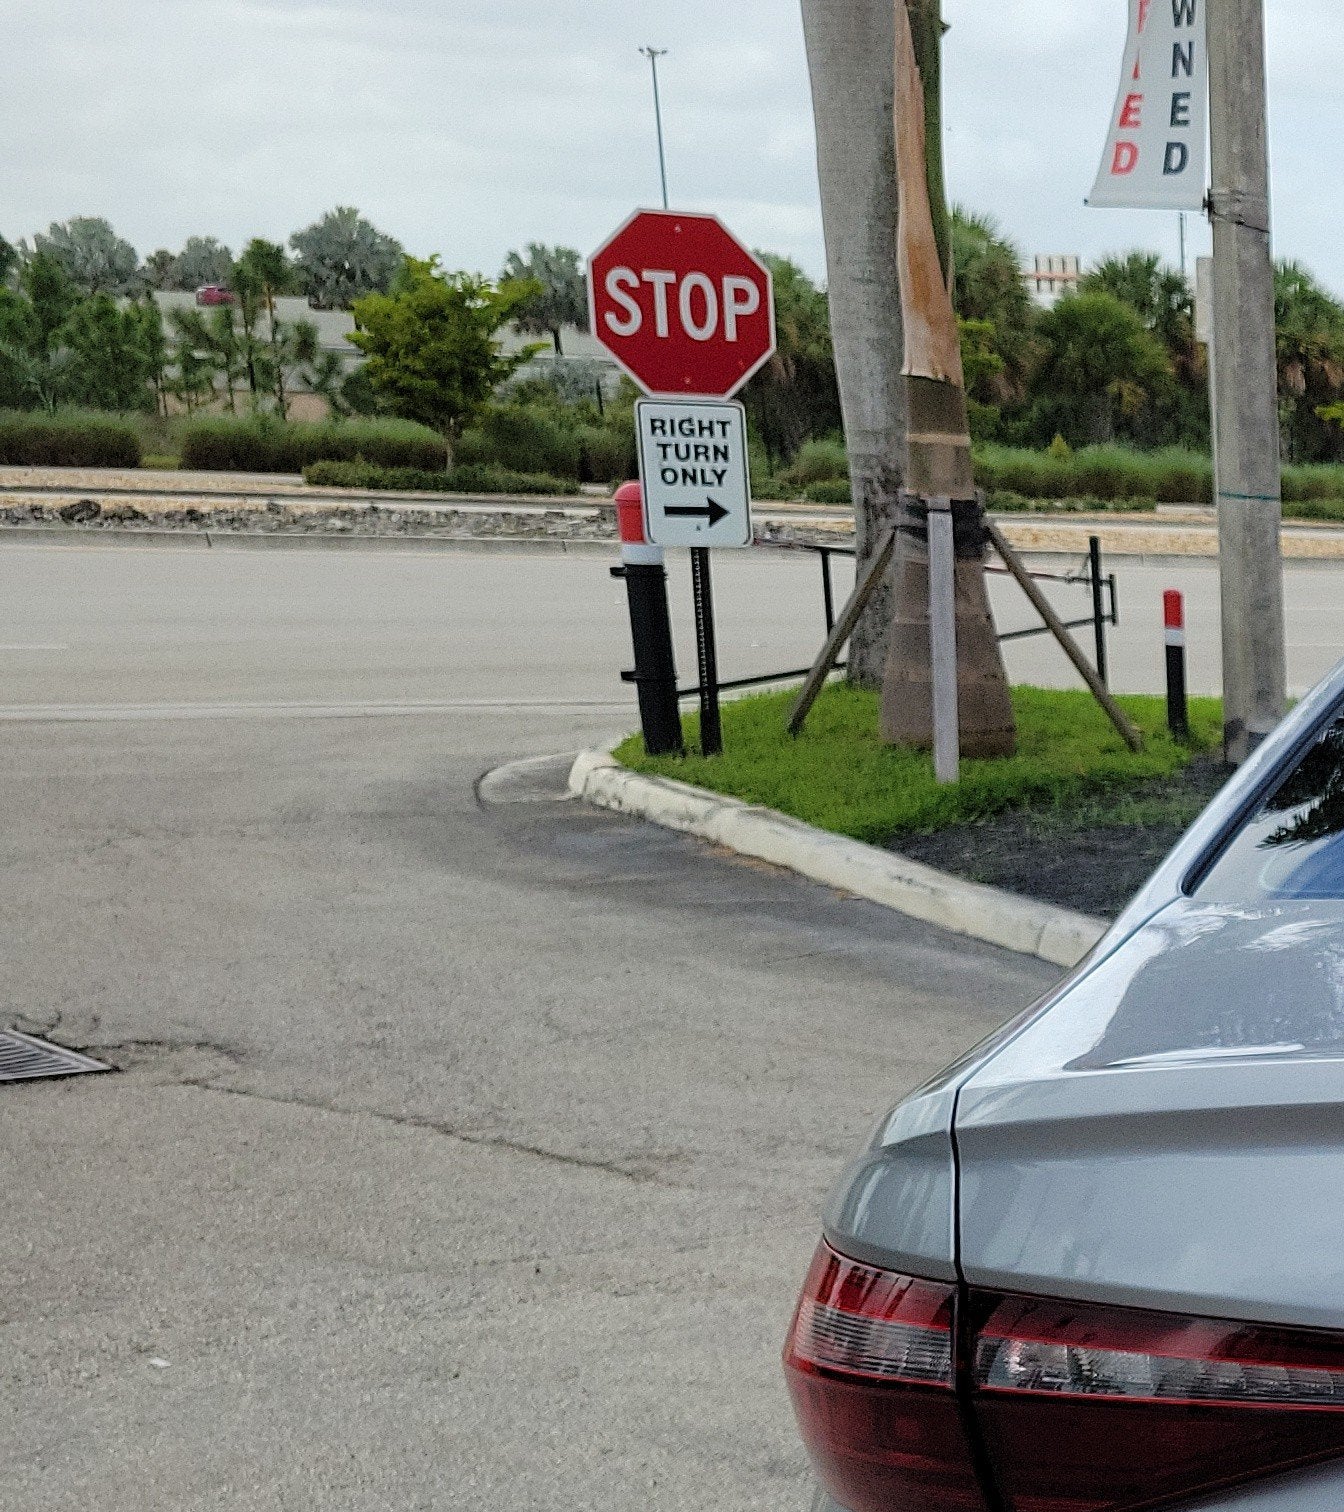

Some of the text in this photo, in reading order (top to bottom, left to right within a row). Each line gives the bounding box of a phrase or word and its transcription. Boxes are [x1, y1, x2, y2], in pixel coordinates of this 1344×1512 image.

[603, 266, 761, 343] STOP
[649, 417, 732, 437] RIGHT
[656, 442, 730, 463] TURN
[660, 466, 728, 487] ONLY
